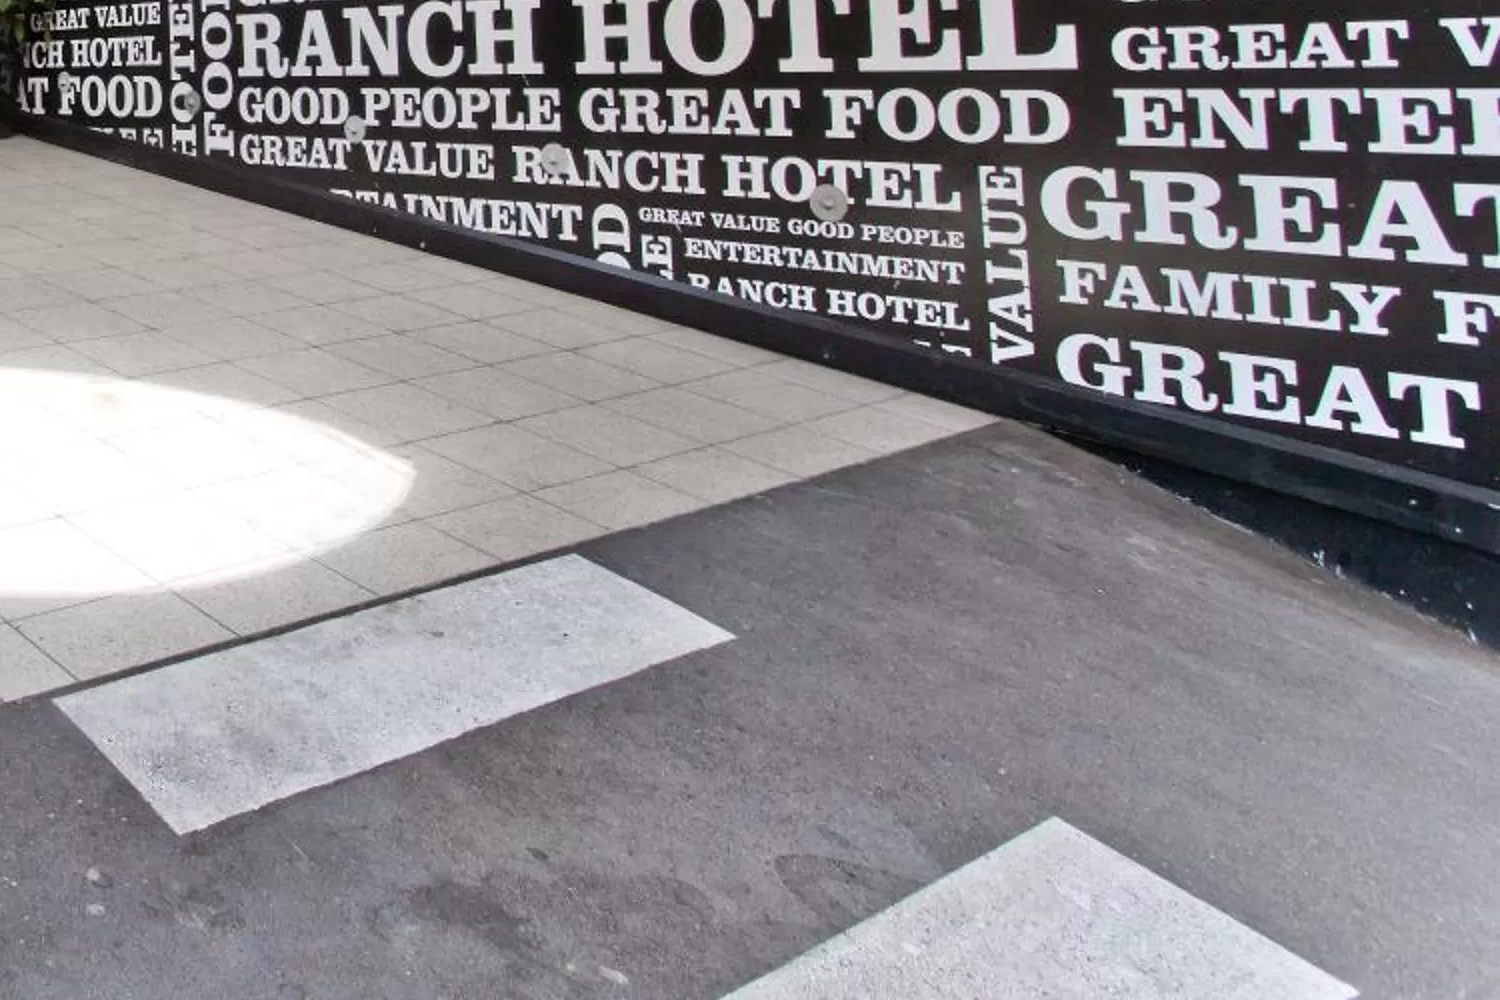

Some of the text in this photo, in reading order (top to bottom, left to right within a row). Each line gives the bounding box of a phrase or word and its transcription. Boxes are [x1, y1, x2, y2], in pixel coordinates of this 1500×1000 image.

[95, 1, 162, 29] VALUE
[70, 35, 163, 69] HOTEL
[1111, 18, 1409, 71] GREAT
[57, 74, 163, 118] FOOD
[239, 85, 349, 126] GOOD
[360, 87, 562, 132] PEOPLE
[578, 86, 800, 137] GREAT
[823, 87, 1071, 145] FOOD
[240, 134, 963, 213] GREAT VALUE RANCH HOTEL
[638, 206, 966, 249] GREAT VALUE GOOD PEOPLE
[684, 237, 966, 285] ENTERTAINMENT
[979, 164, 1036, 365] VALUE
[687, 272, 971, 332] RANCH HOTEL
[1056, 258, 1400, 337] FAMILY
[1056, 332, 1482, 450] GREAT
